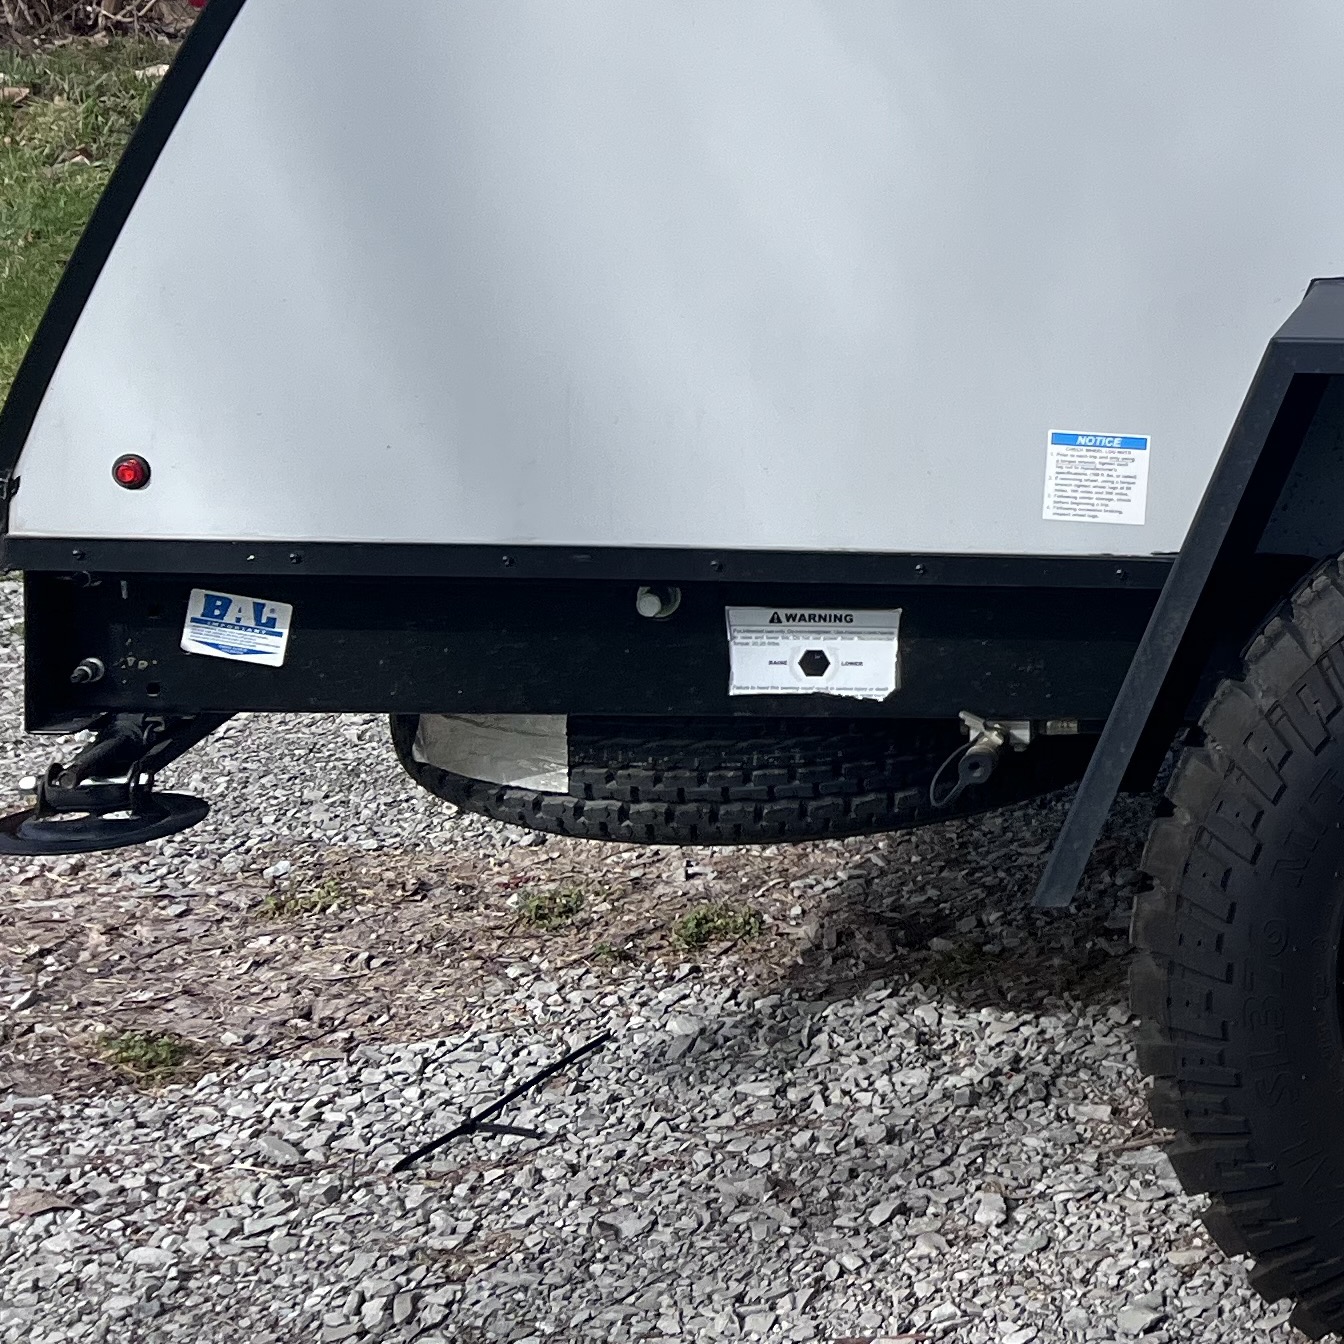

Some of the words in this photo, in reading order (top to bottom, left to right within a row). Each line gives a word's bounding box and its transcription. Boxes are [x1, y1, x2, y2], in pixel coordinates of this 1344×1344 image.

[1076, 436, 1122, 447] NOTICE
[201, 594, 277, 629] BAL
[784, 613, 854, 624] WARNING
